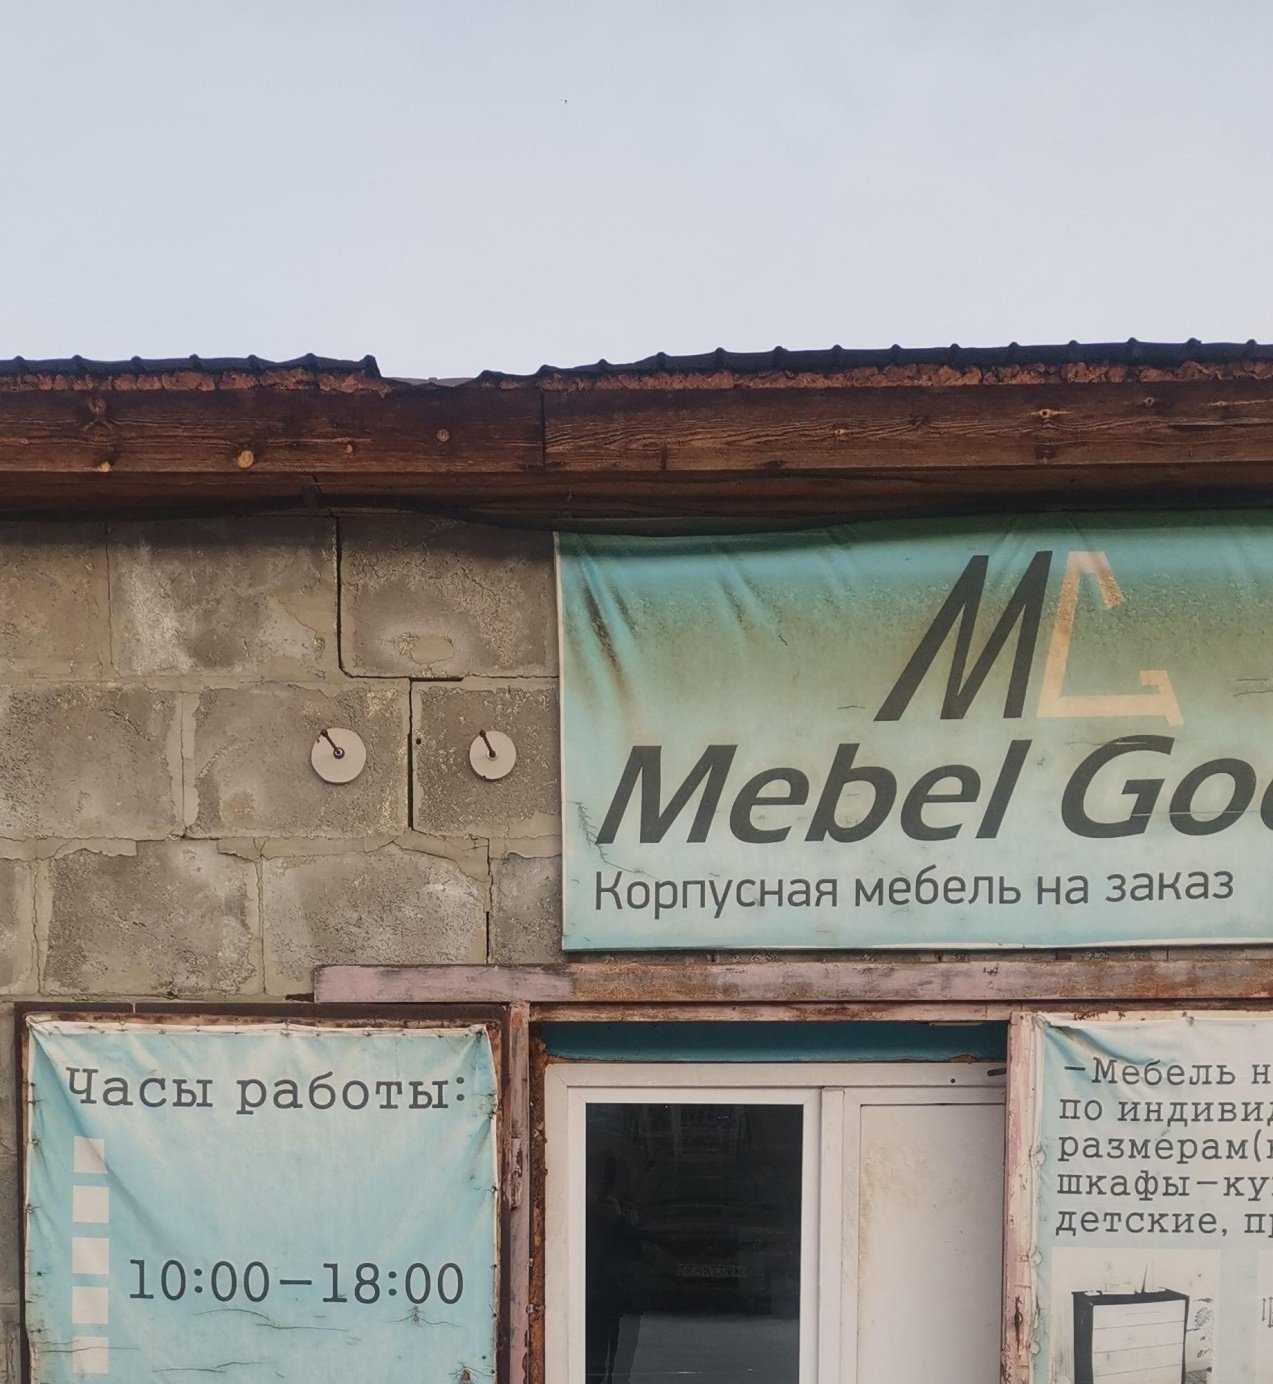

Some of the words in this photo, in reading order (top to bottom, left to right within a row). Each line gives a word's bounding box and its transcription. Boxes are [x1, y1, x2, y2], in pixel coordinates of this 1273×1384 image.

[596, 739, 1032, 845] Mebel
[1061, 734, 1273, 839] Go
[595, 870, 839, 920] Корпусная
[853, 864, 1022, 907] мебель
[1036, 873, 1091, 906] на
[1105, 869, 1235, 903] заказ
[66, 1066, 213, 1108] Часы
[236, 1071, 466, 1115] работы:
[1059, 1098, 1103, 1121] по
[1057, 1171, 1273, 1202] шкафы-ку
[1056, 1210, 1228, 1237] детские,
[1244, 1213, 1273, 1239] п
[129, 1259, 464, 1304] 10:00-18:00
